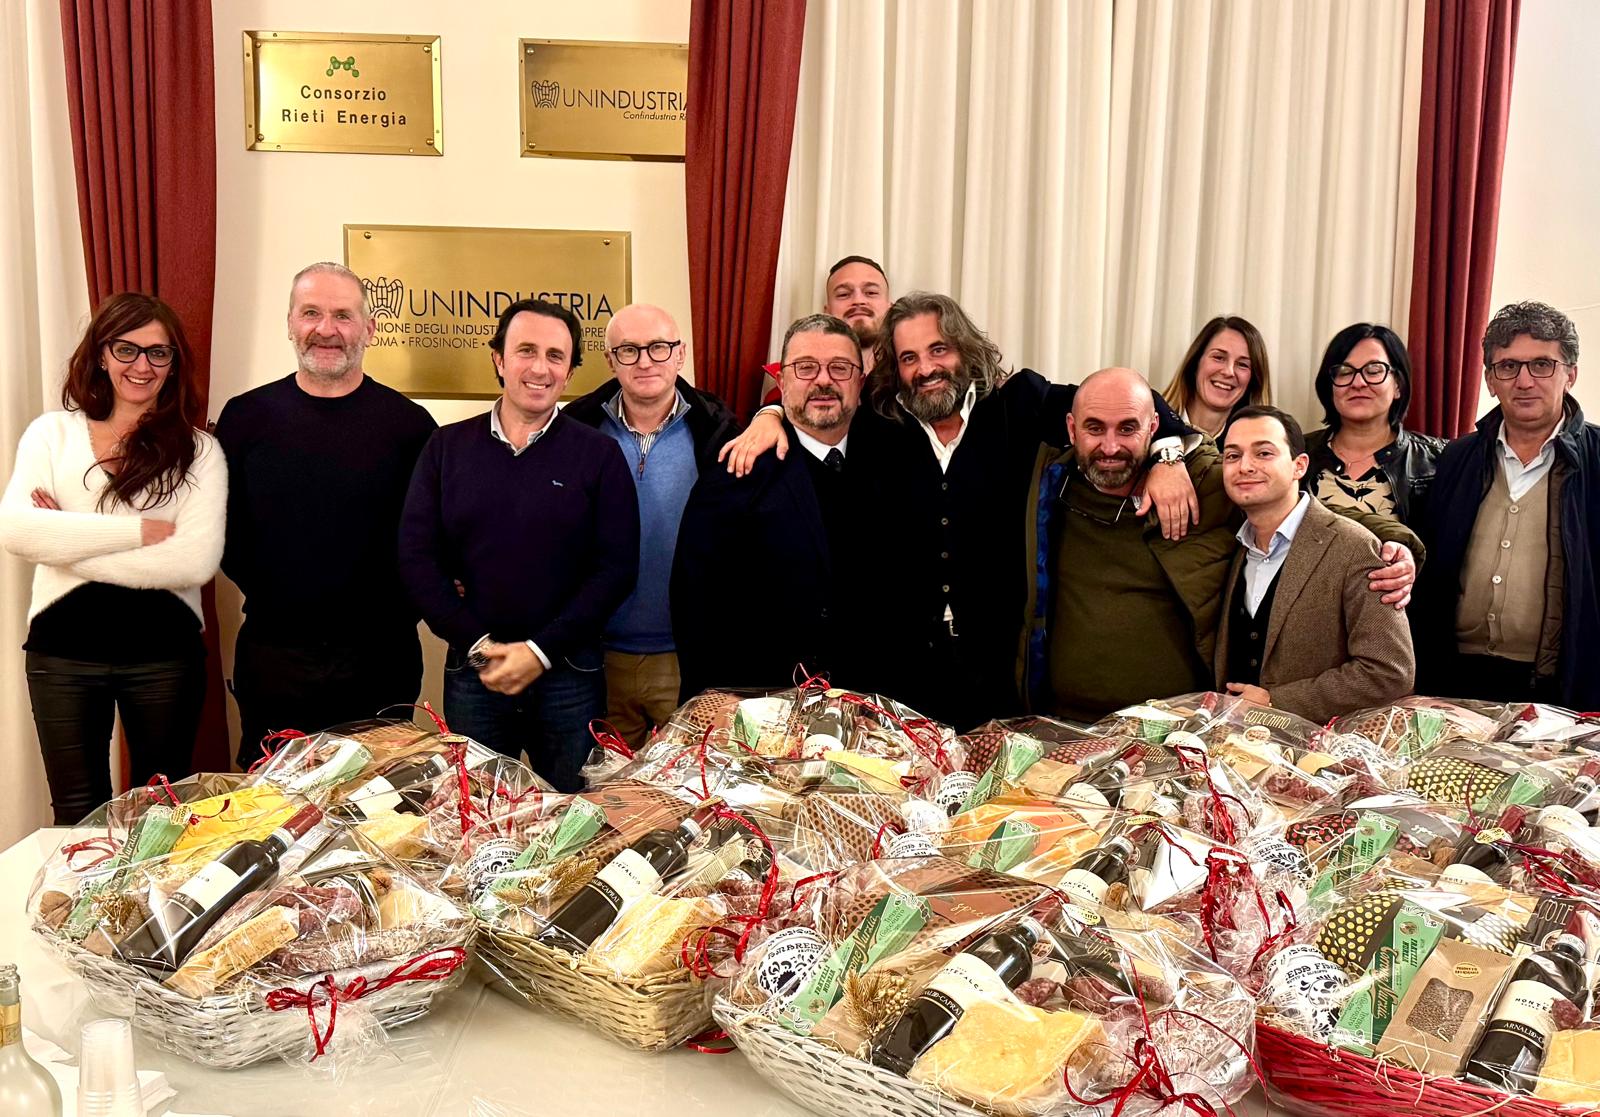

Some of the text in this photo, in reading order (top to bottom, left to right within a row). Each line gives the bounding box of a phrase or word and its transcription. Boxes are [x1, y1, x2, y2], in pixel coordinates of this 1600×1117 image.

[300, 85, 387, 101] Consorzio
[281, 109, 407, 128] Rieti Energia
[623, 111, 677, 121] Confindustria
[374, 322, 411, 334] NIONE
[414, 323, 449, 335] DEGLI
[366, 337, 606, 352] OMA FROSINONE TERB
